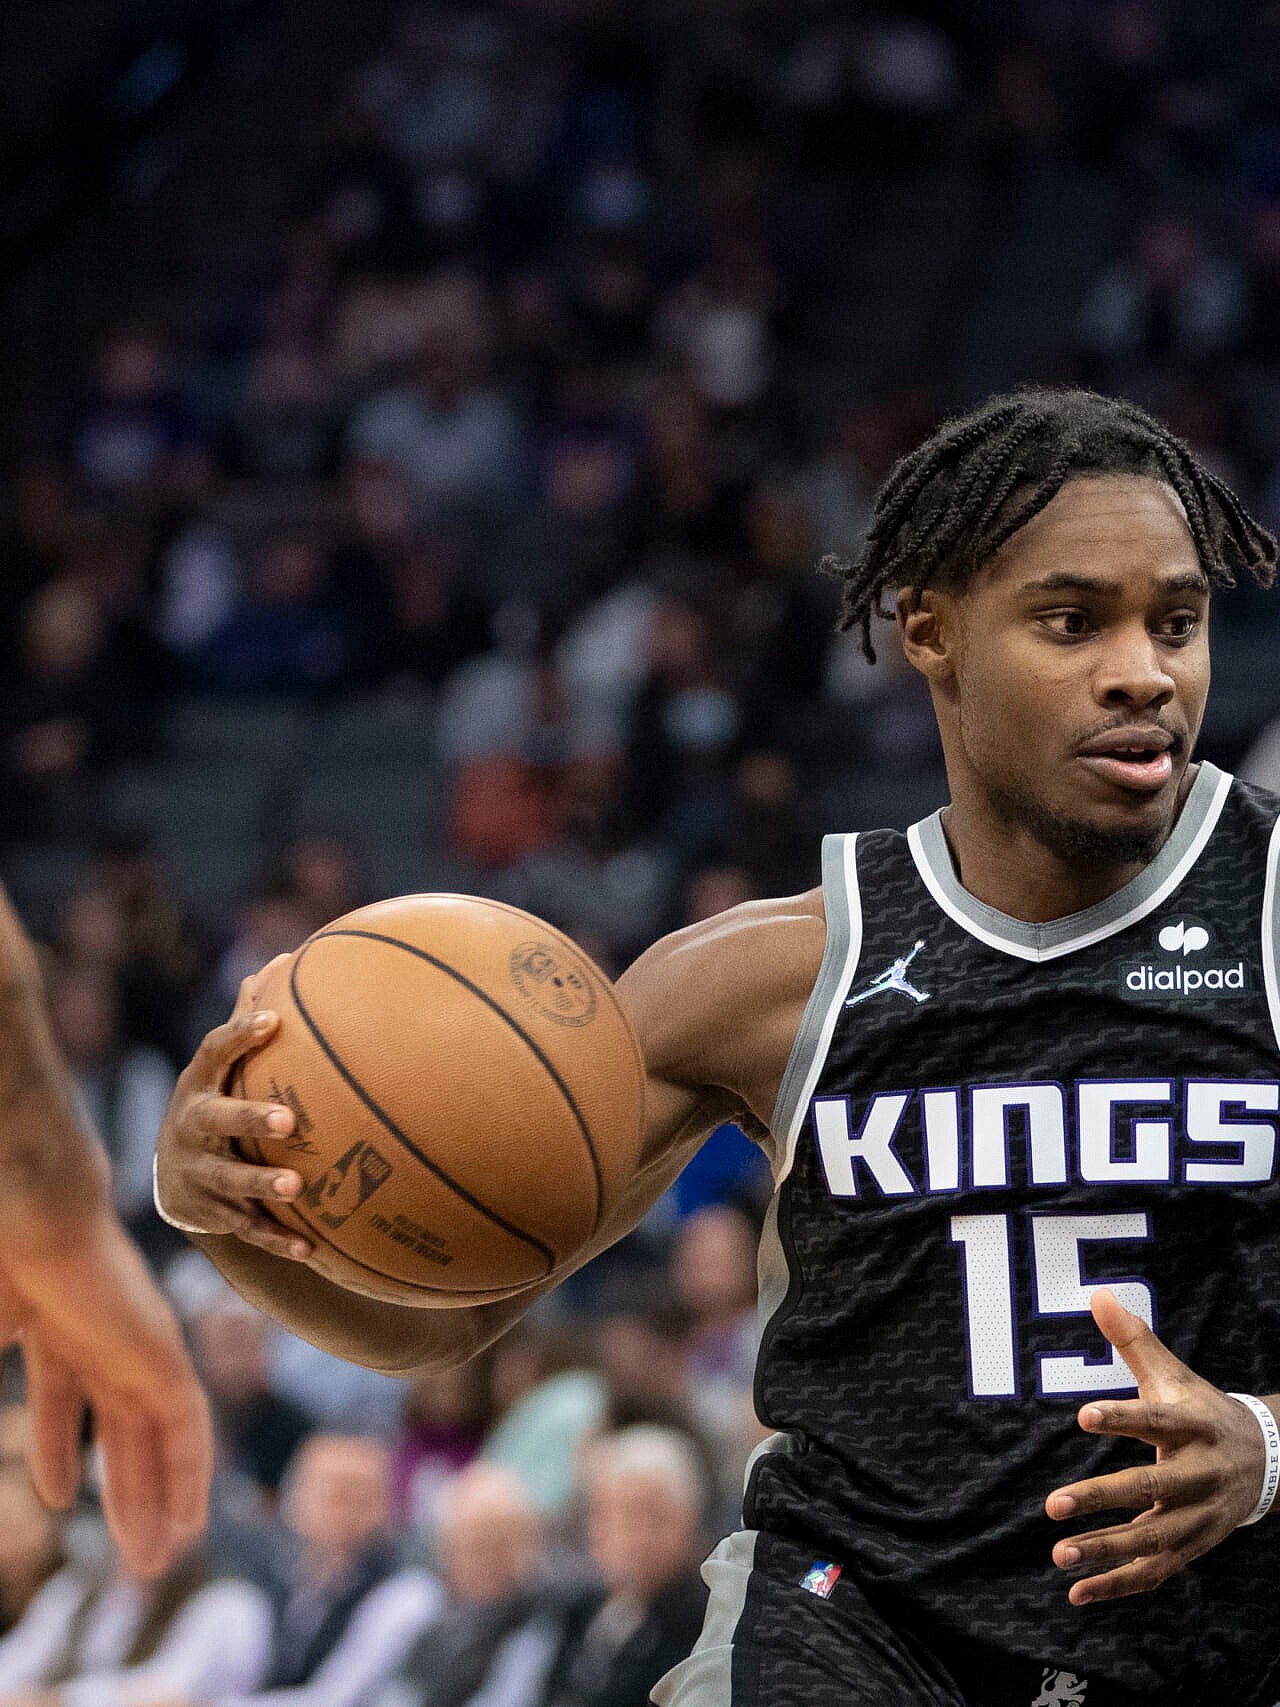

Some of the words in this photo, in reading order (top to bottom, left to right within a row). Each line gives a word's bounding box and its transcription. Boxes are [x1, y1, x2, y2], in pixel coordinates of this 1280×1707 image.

[1125, 962, 1245, 996] dialpad
[947, 1210, 1156, 1398] 15
[1257, 1455, 1279, 1515] HUMBLE
